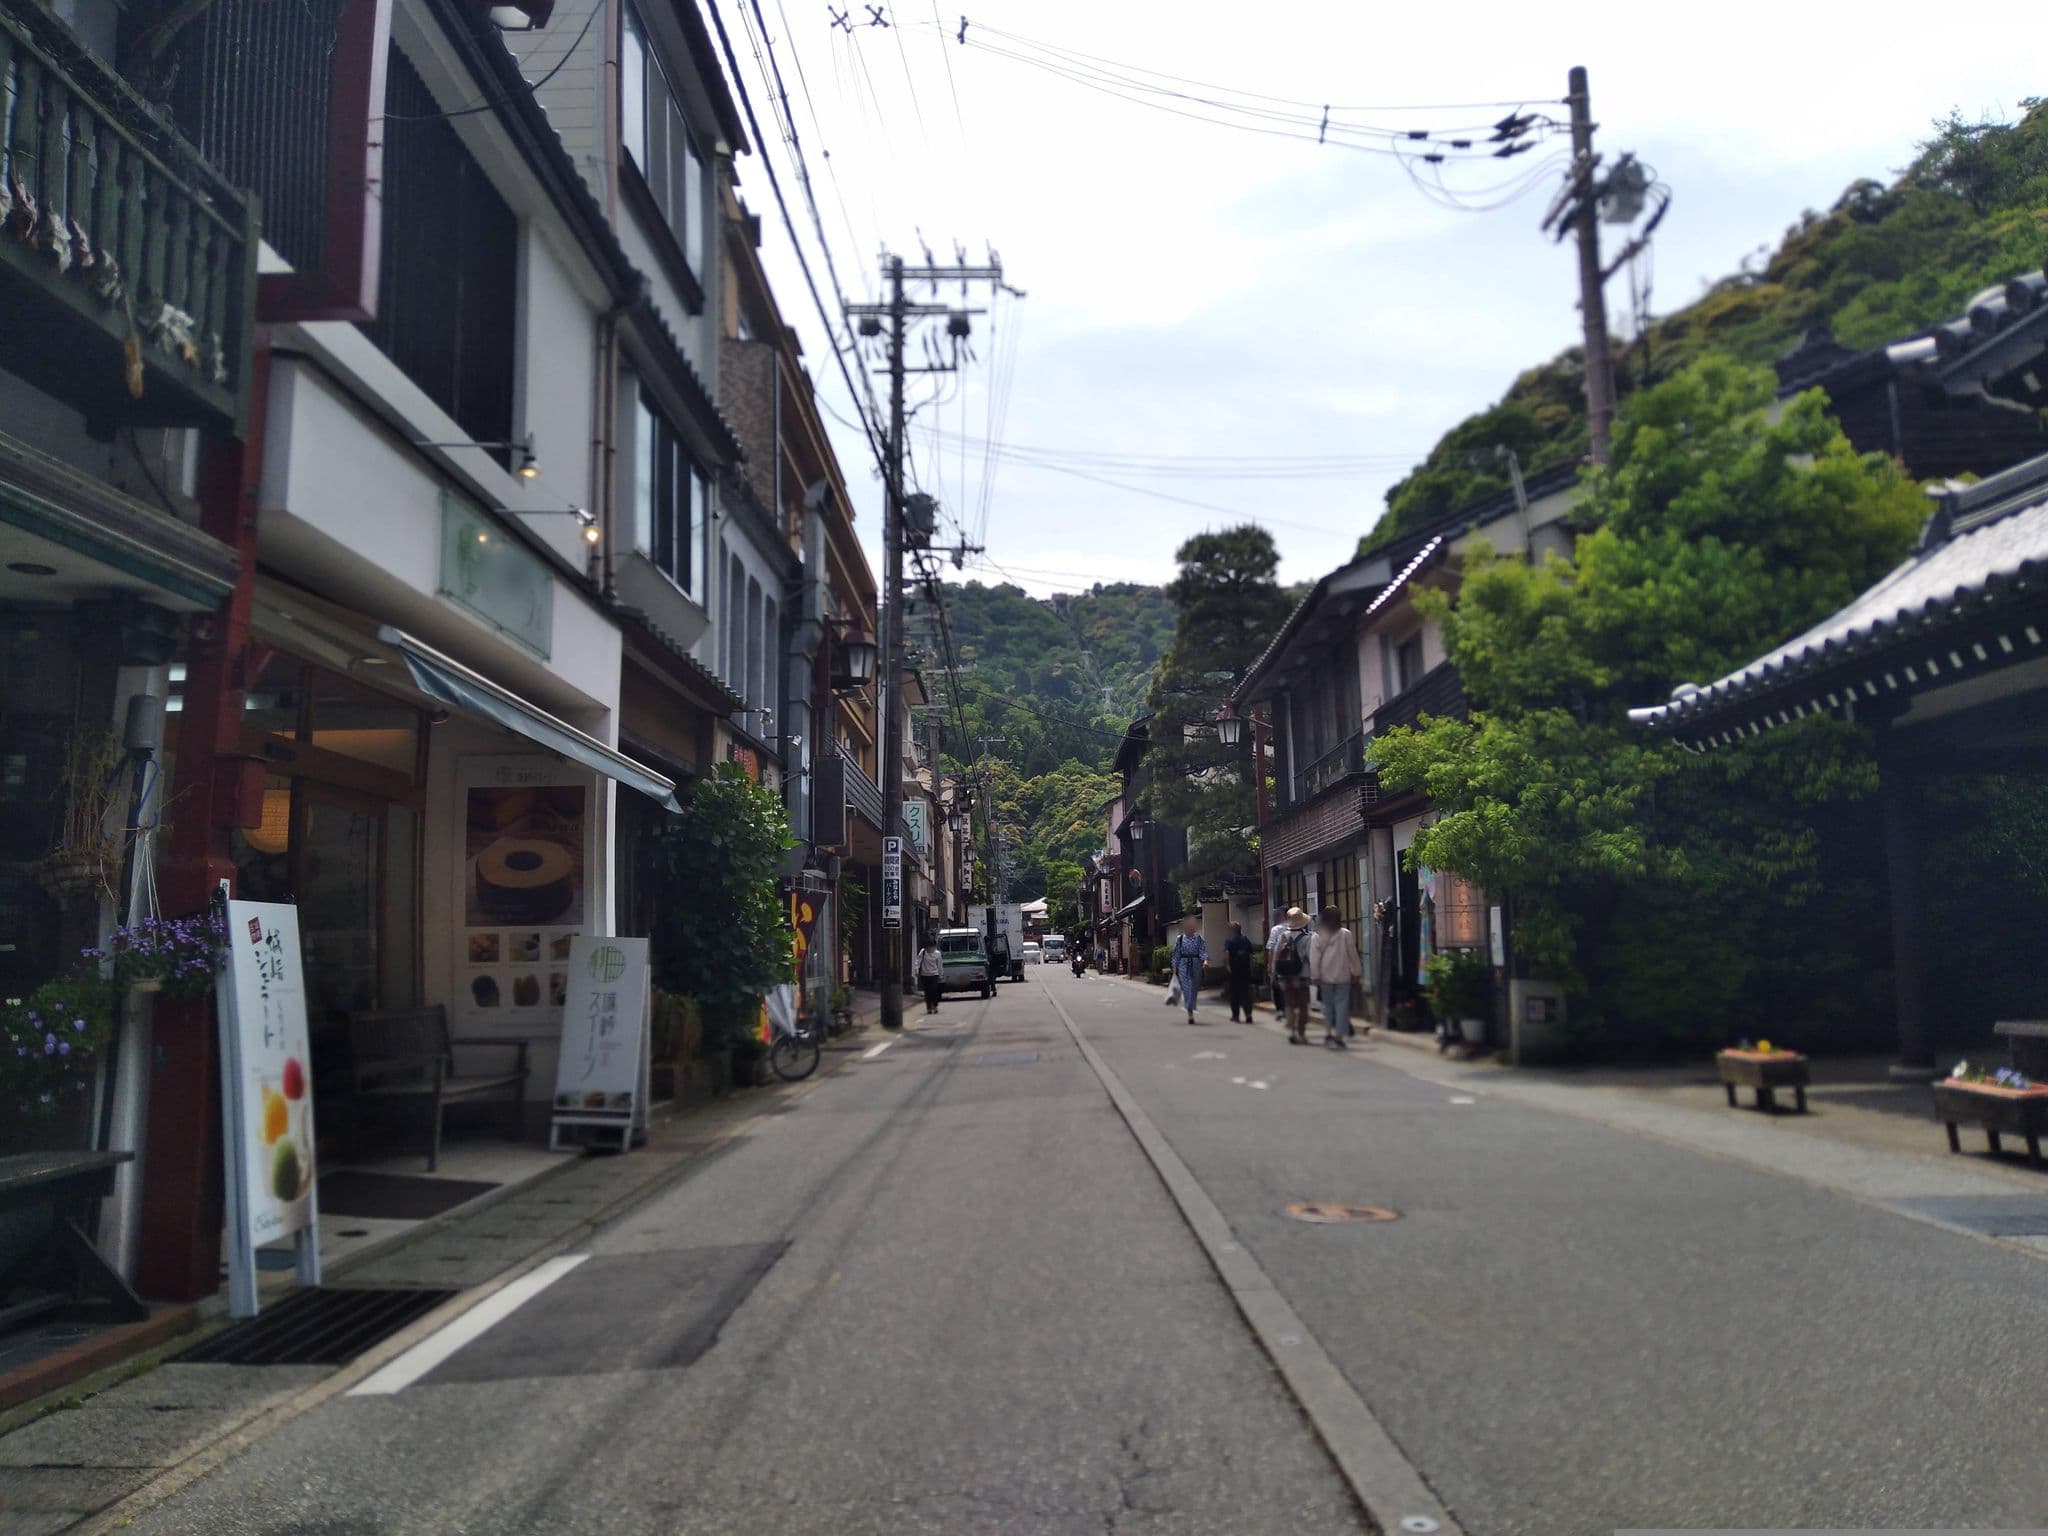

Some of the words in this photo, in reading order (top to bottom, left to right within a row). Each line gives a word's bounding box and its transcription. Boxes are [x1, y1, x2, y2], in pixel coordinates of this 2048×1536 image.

[909, 806, 921, 842] クスリ
[887, 841, 897, 851] P
